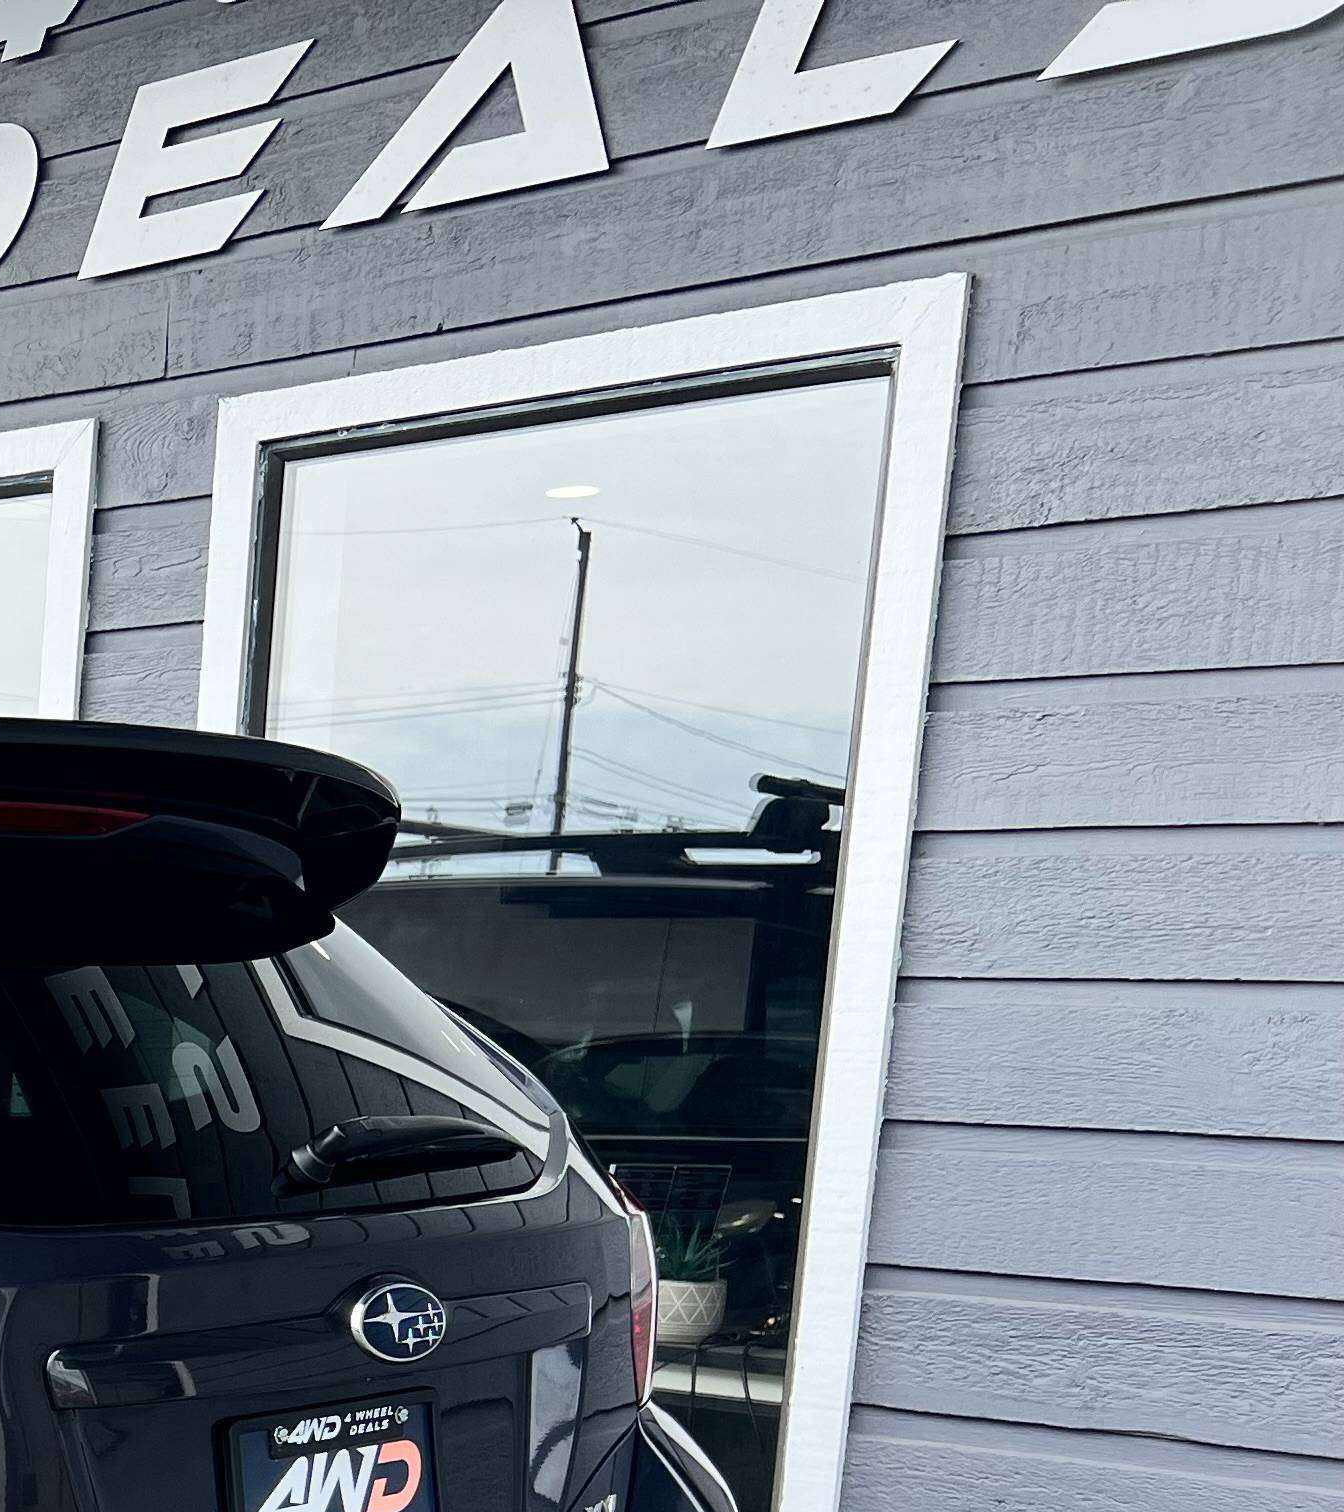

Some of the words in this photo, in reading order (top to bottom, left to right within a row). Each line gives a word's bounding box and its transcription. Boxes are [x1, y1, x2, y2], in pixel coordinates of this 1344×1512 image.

[287, 1415, 342, 1445] 4WD
[344, 1412, 352, 1424] 4
[355, 1405, 394, 1421] WHEEL
[349, 1418, 390, 1437] DEALS
